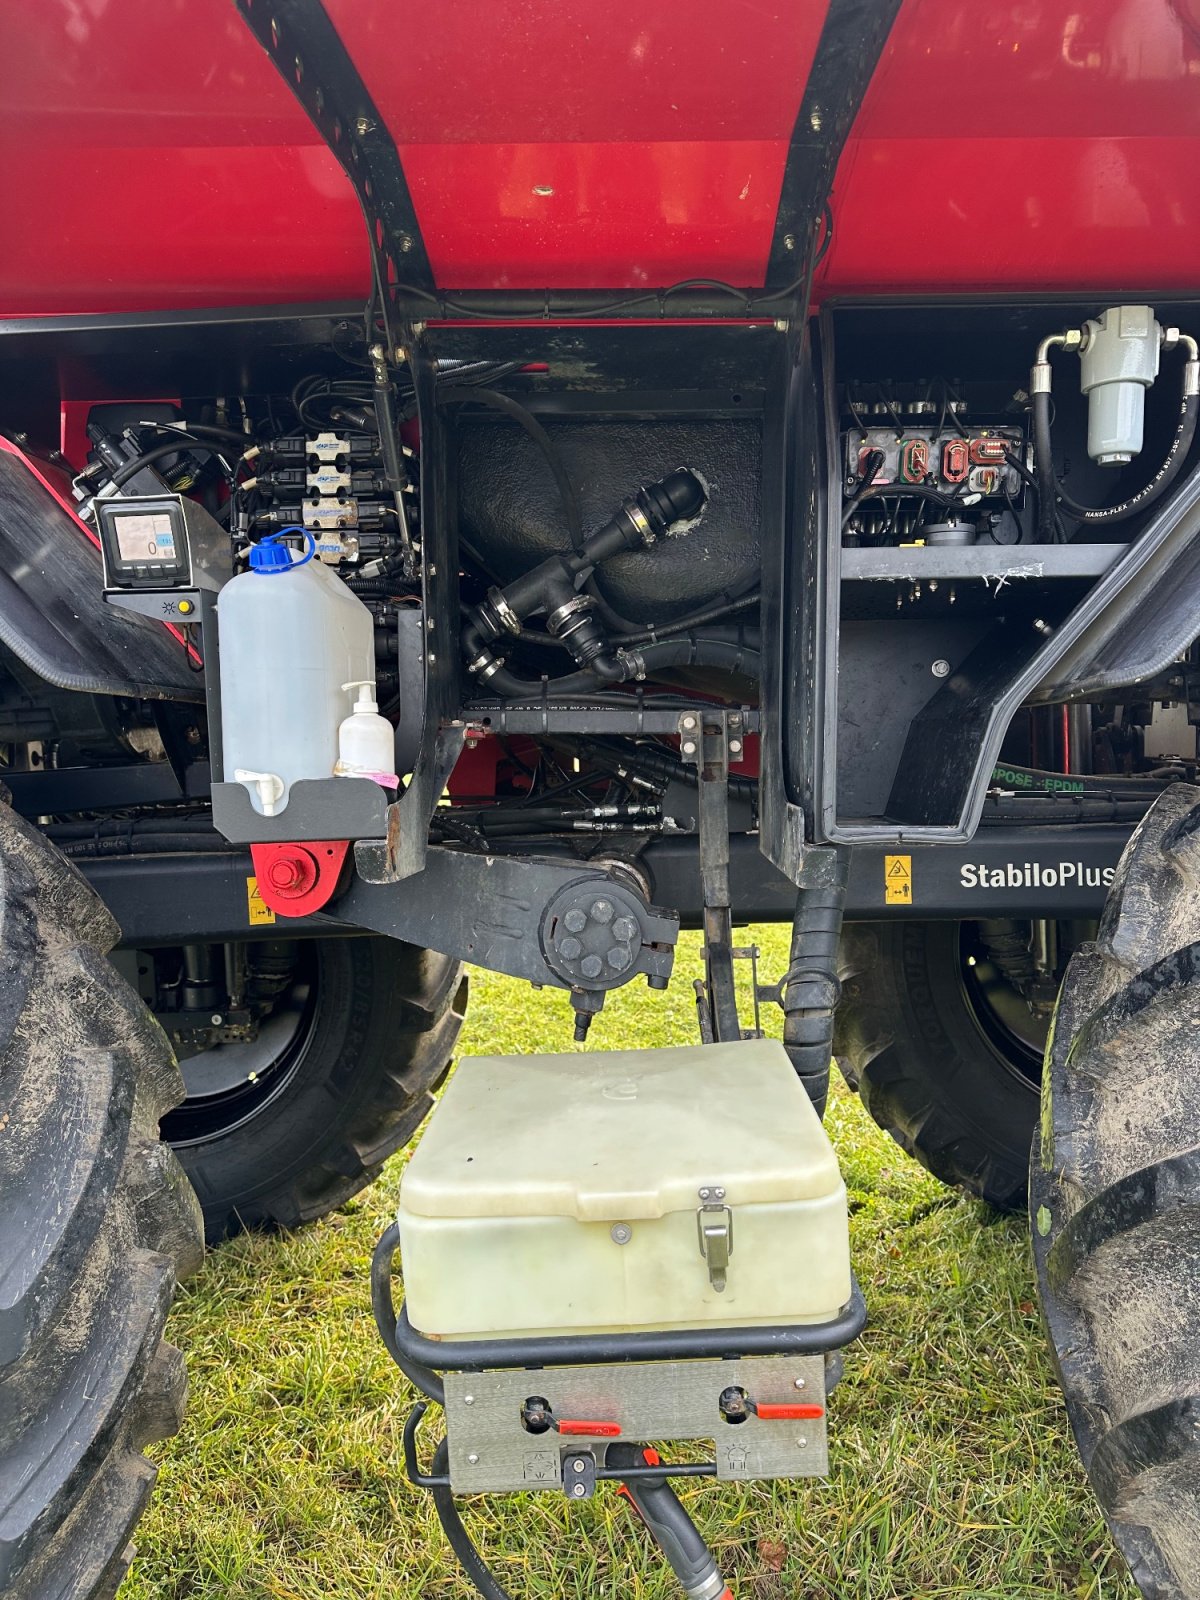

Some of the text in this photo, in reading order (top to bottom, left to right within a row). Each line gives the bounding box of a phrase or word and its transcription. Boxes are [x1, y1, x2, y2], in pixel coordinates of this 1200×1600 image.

[1085, 503, 1128, 518] HANSA-FLEX
[147, 541, 157, 555] 0
[1044, 778, 1084, 793] EPDM
[960, 862, 1116, 888] StabiloPlus
